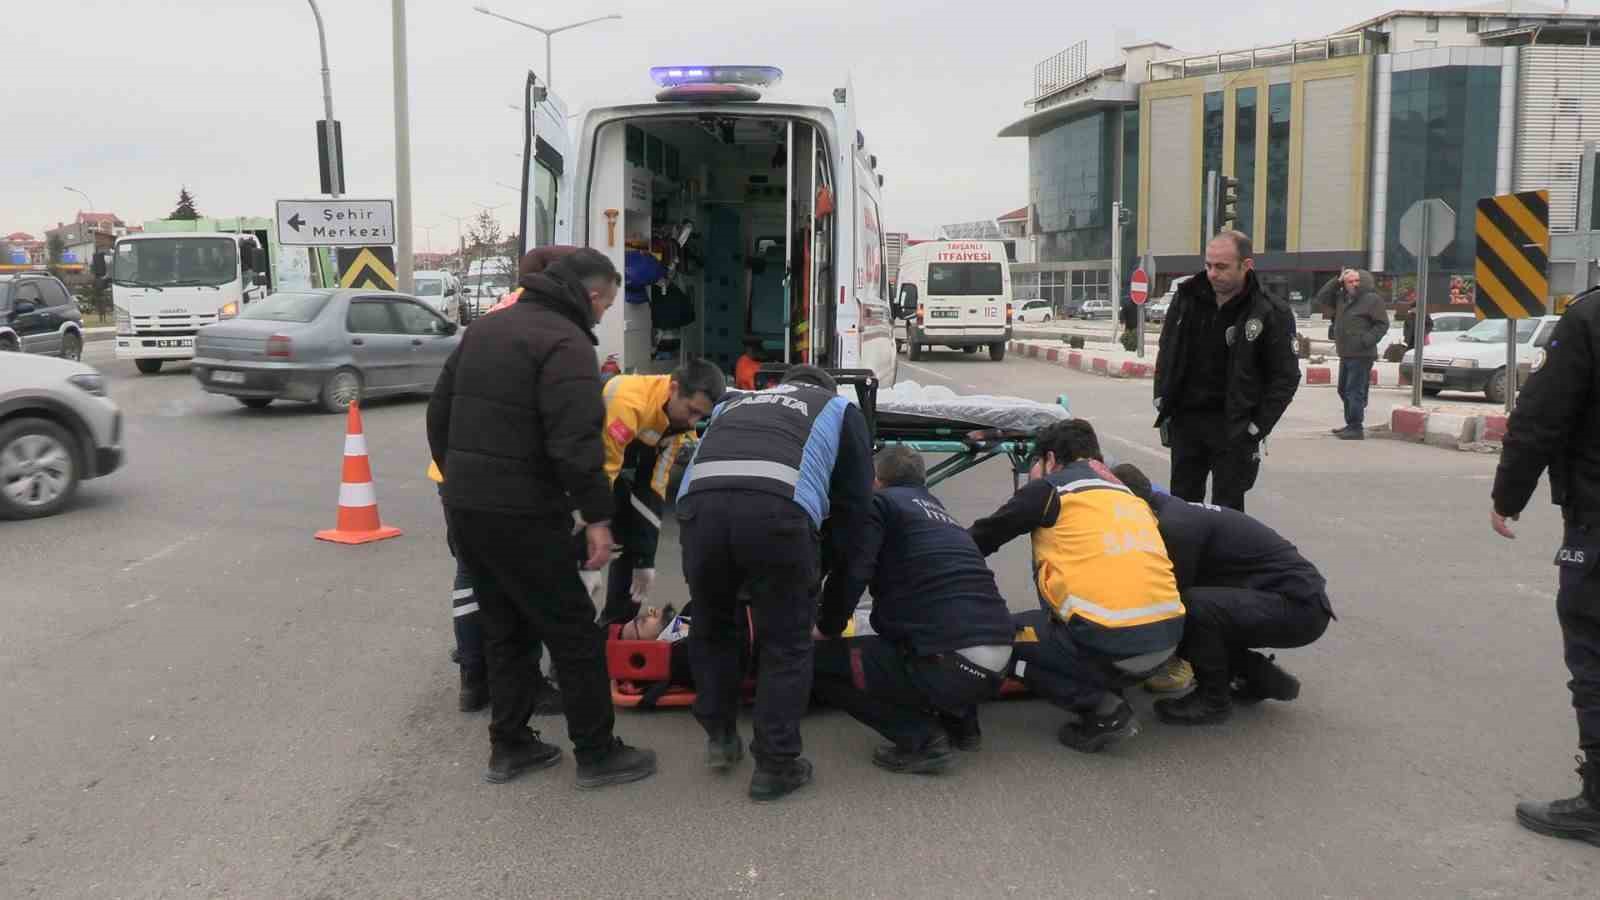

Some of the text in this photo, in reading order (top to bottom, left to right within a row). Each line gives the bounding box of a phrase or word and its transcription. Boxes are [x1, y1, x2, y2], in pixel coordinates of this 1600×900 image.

[322, 208, 374, 221] Şehir
[312, 226, 386, 238] Merkezi
[937, 251, 992, 261] İTFAİYESİ
[984, 306, 998, 317] 112
